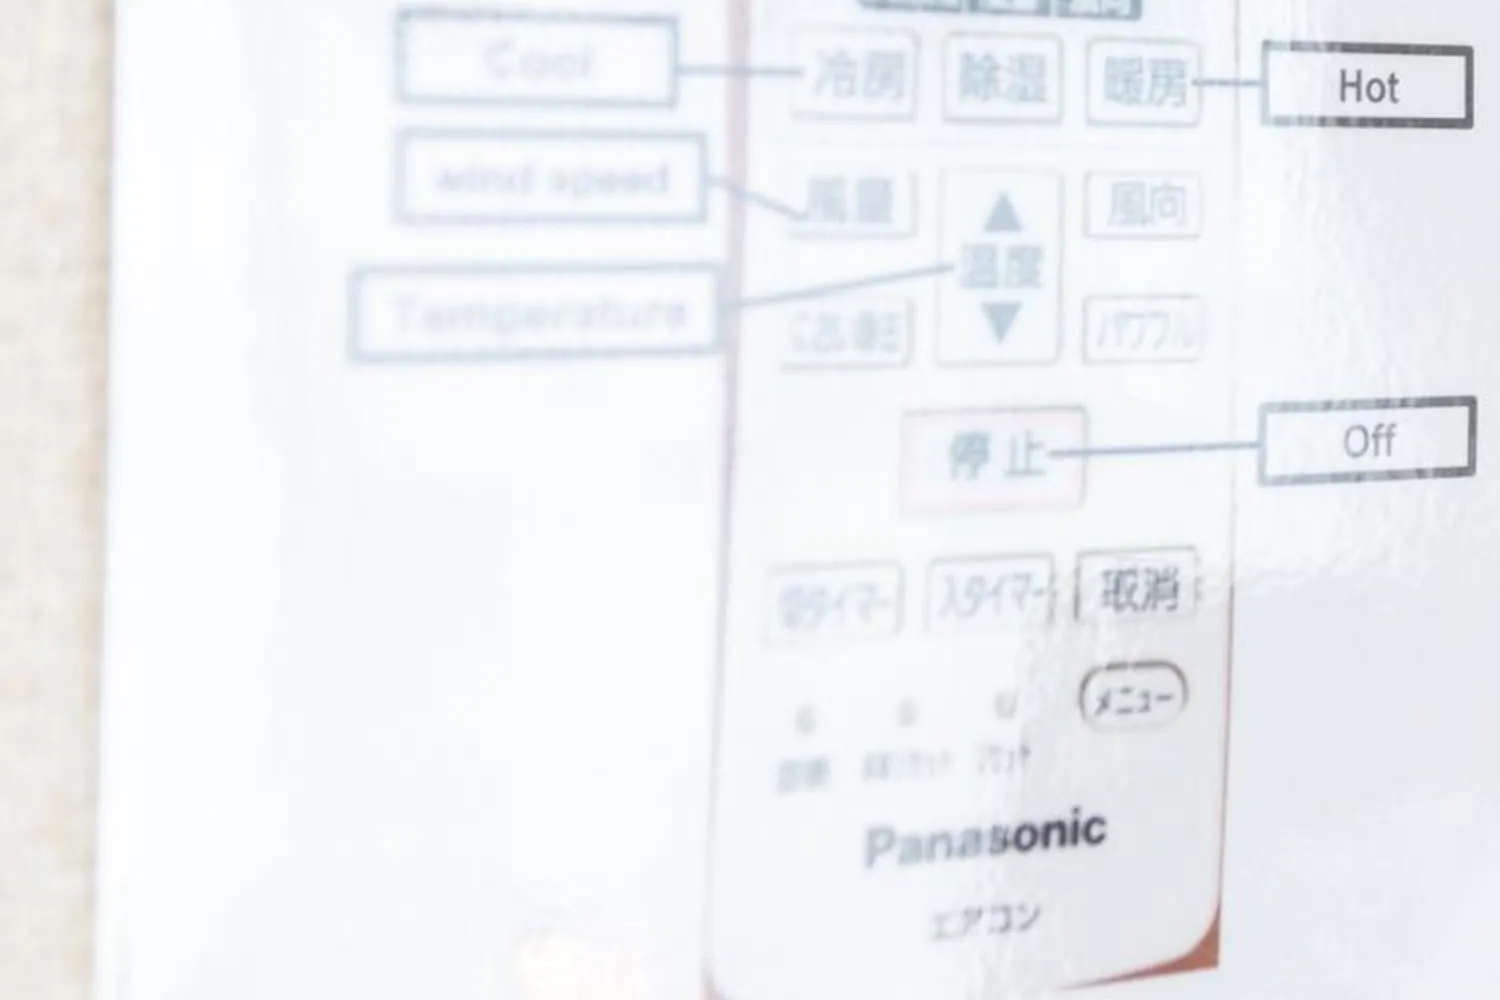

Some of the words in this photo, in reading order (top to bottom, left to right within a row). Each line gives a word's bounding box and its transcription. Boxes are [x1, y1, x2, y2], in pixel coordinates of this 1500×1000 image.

[1339, 68, 1400, 104] Hot
[948, 428, 1047, 482] 停止
[1343, 422, 1399, 459] Off
[1100, 564, 1180, 614] 取消
[1095, 684, 1174, 719] メニュー
[863, 804, 1109, 870] Panasonic
[929, 901, 1042, 943] エアコン
